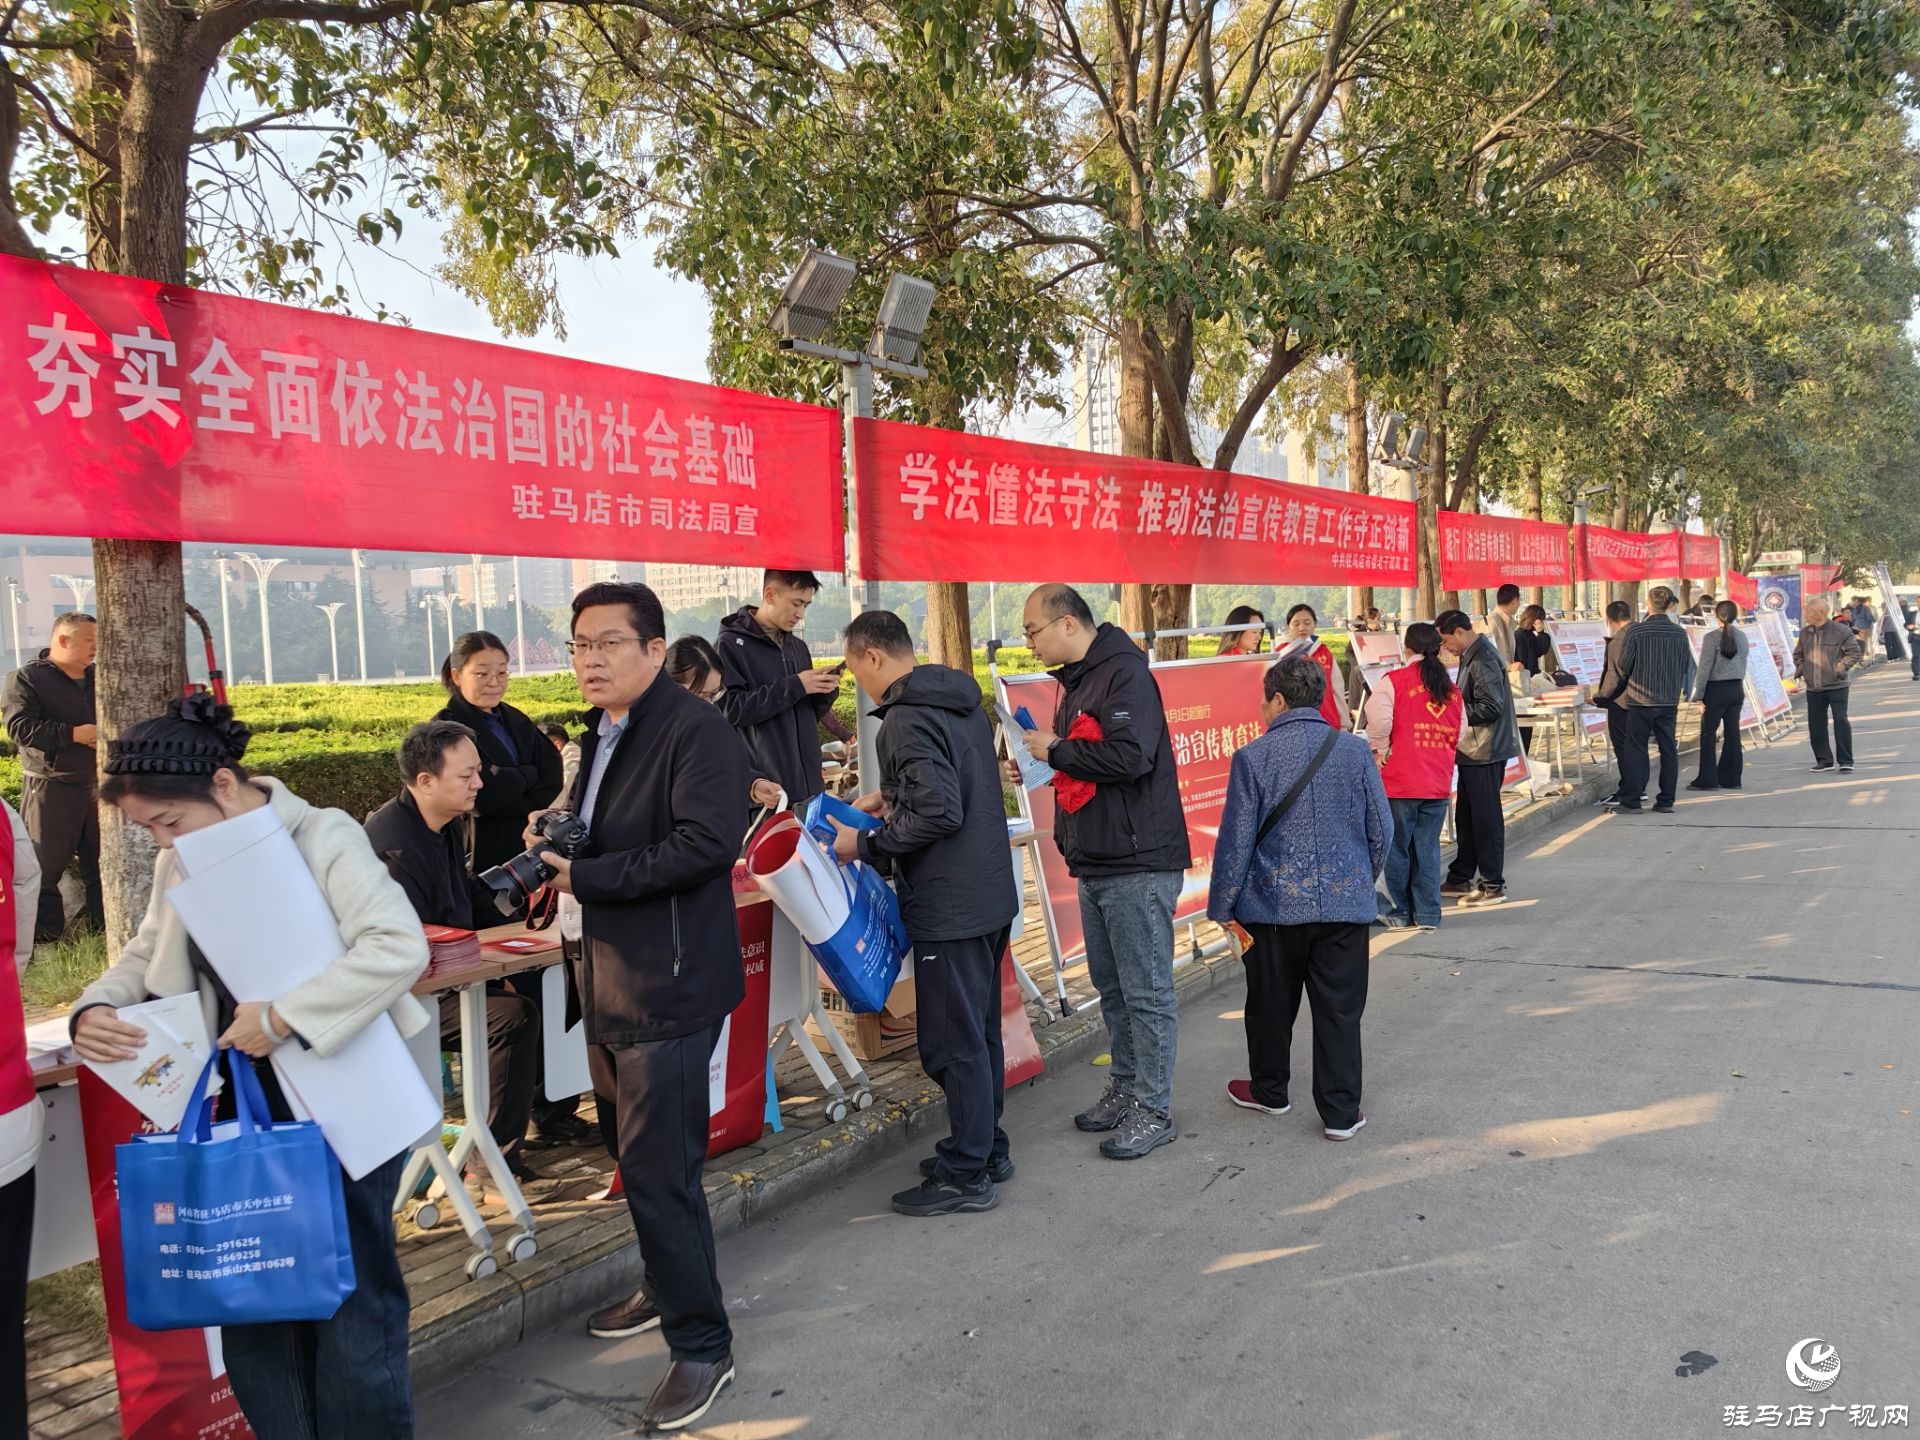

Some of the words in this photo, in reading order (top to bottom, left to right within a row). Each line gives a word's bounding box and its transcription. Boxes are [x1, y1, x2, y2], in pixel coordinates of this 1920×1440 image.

[27, 312, 757, 490] 夯实全面依法治国的社会基础
[512, 484, 759, 537] 驻马店市司法局宣
[899, 453, 1120, 531] 学法懂法守法
[1137, 480, 1409, 554] 推动法治宣传教育工作守正创新
[1172, 721, 1263, 766] 治宣传教育法
[216, 1249, 261, 1265] 3669258
